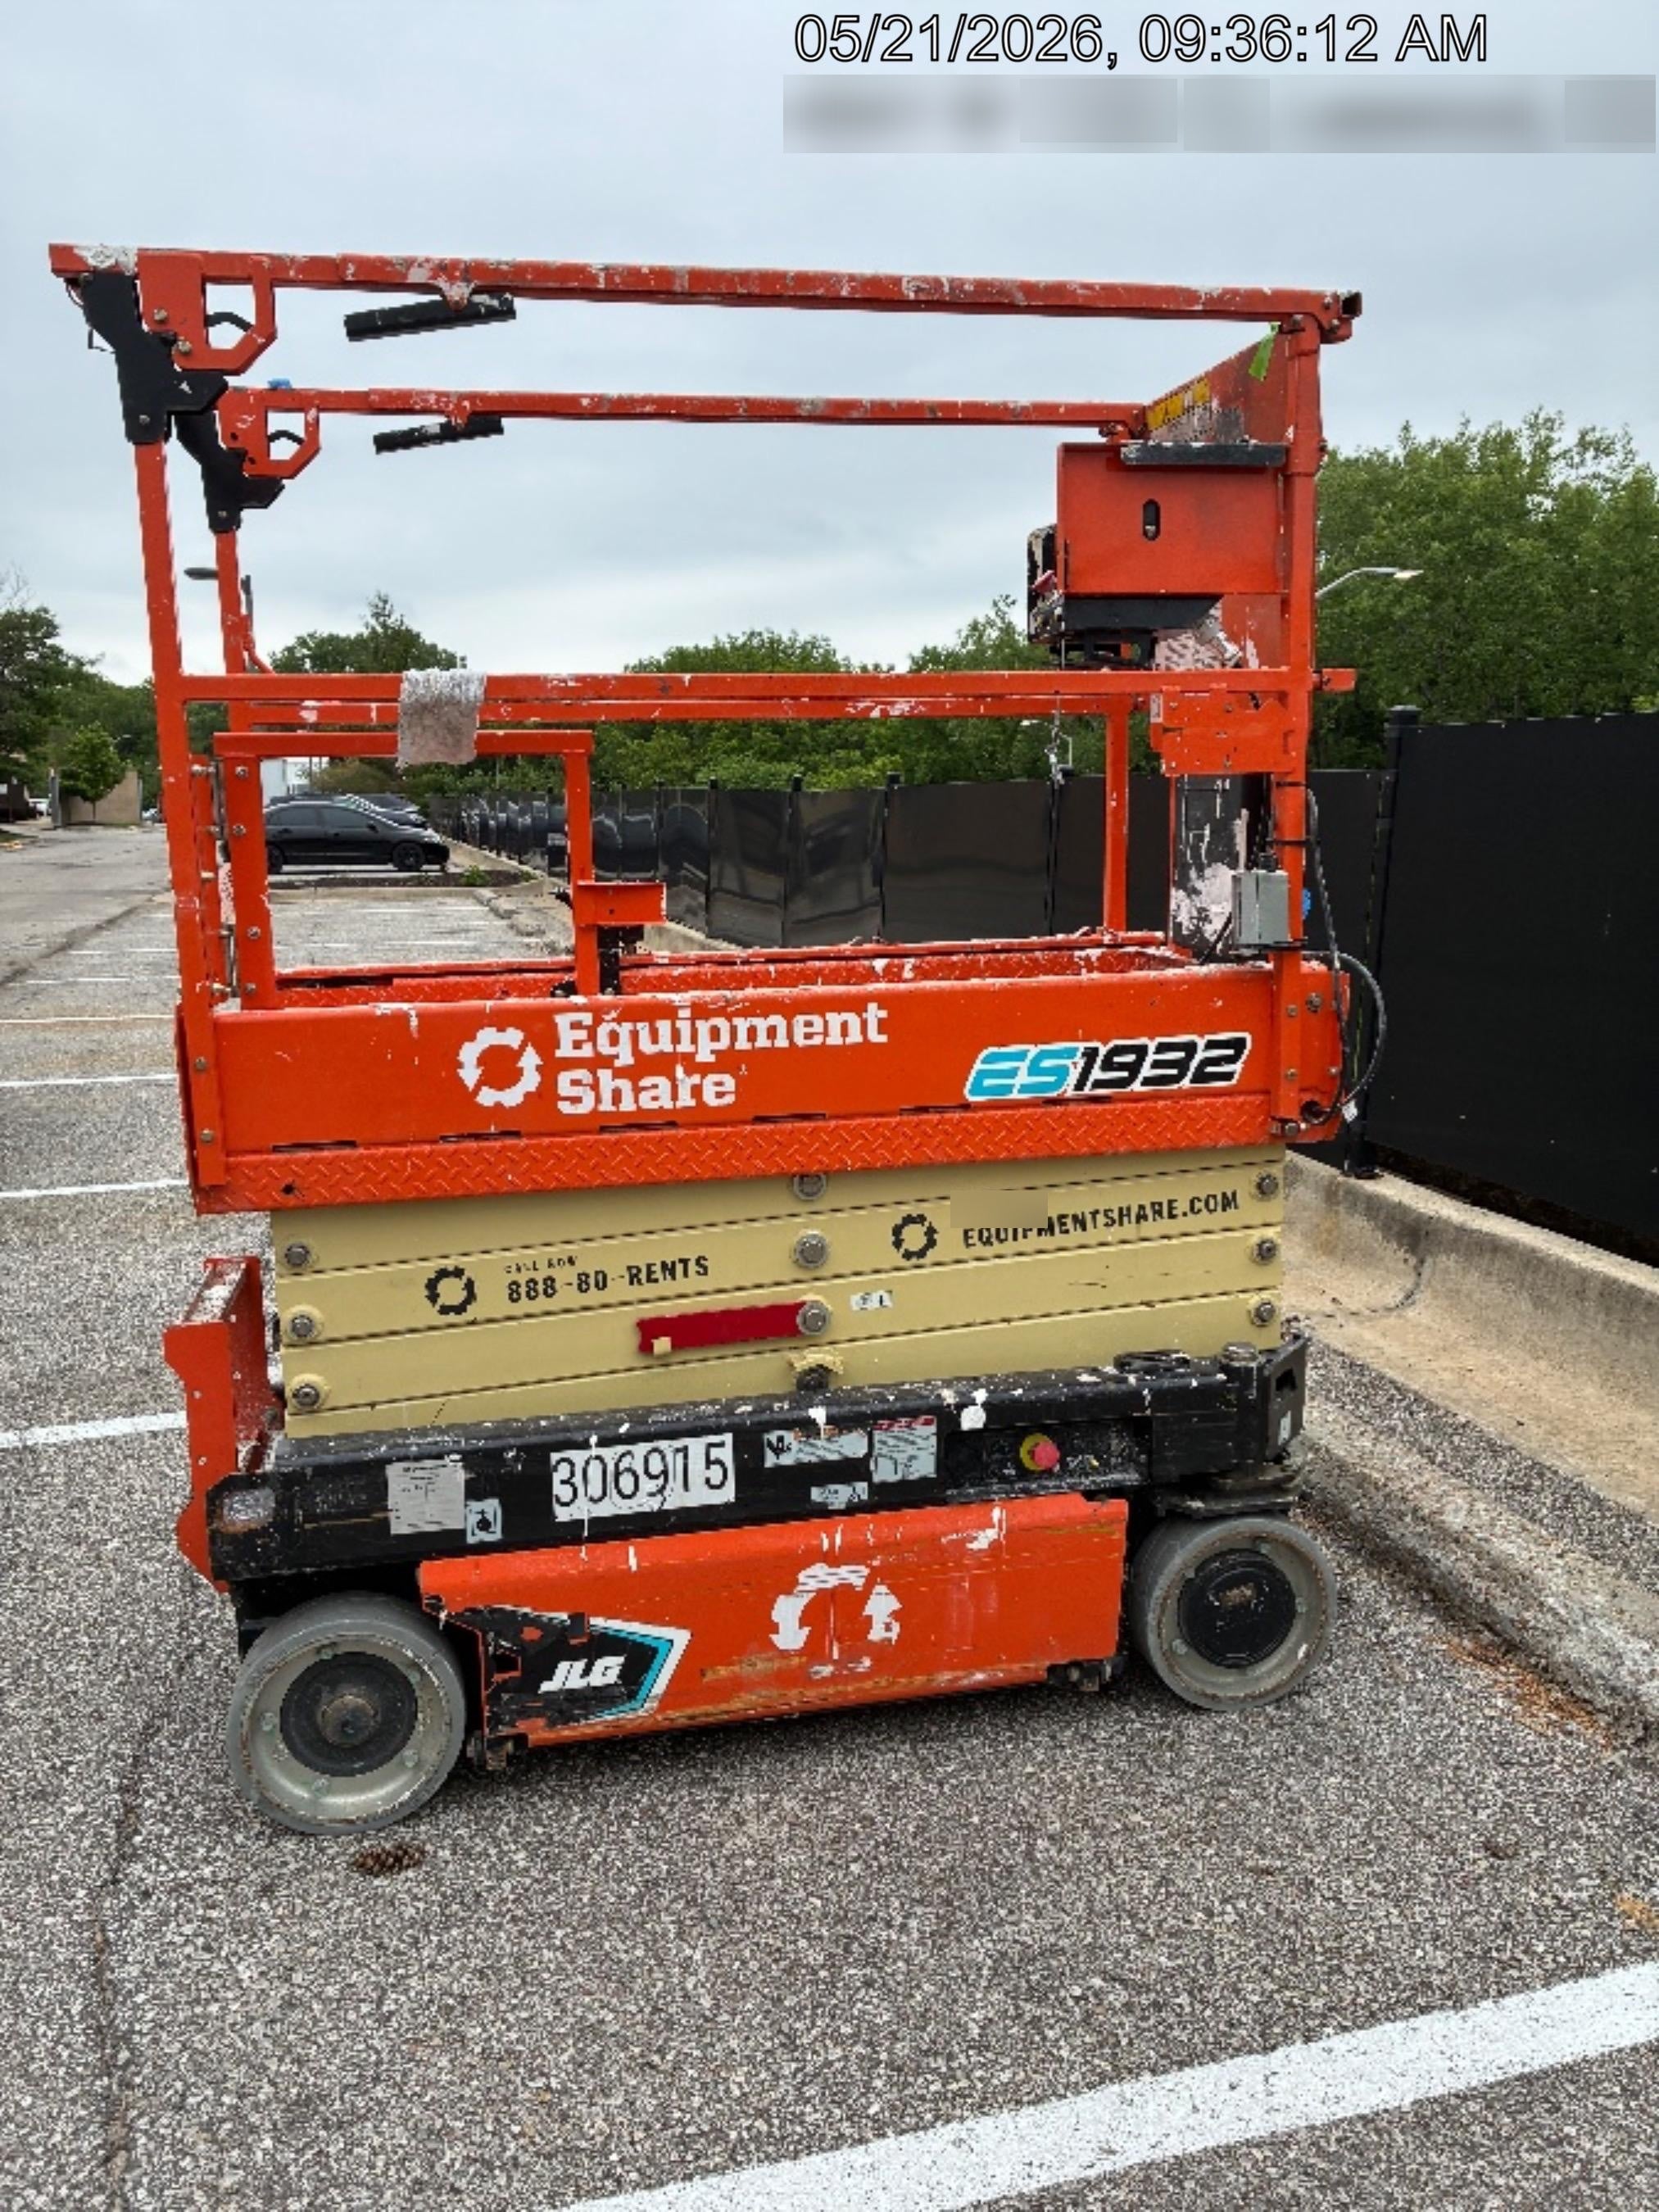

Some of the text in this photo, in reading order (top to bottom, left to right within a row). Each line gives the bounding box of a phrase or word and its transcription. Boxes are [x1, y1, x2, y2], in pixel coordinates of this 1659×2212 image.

[553, 1001, 888, 1067] Equipment
[556, 1067, 736, 1115] Share
[964, 1033, 1251, 1100] ES1932
[507, 1255, 709, 1303] 888-80-RENTS
[552, 1439, 728, 1507] 306915
[537, 1655, 626, 1694] JLG
